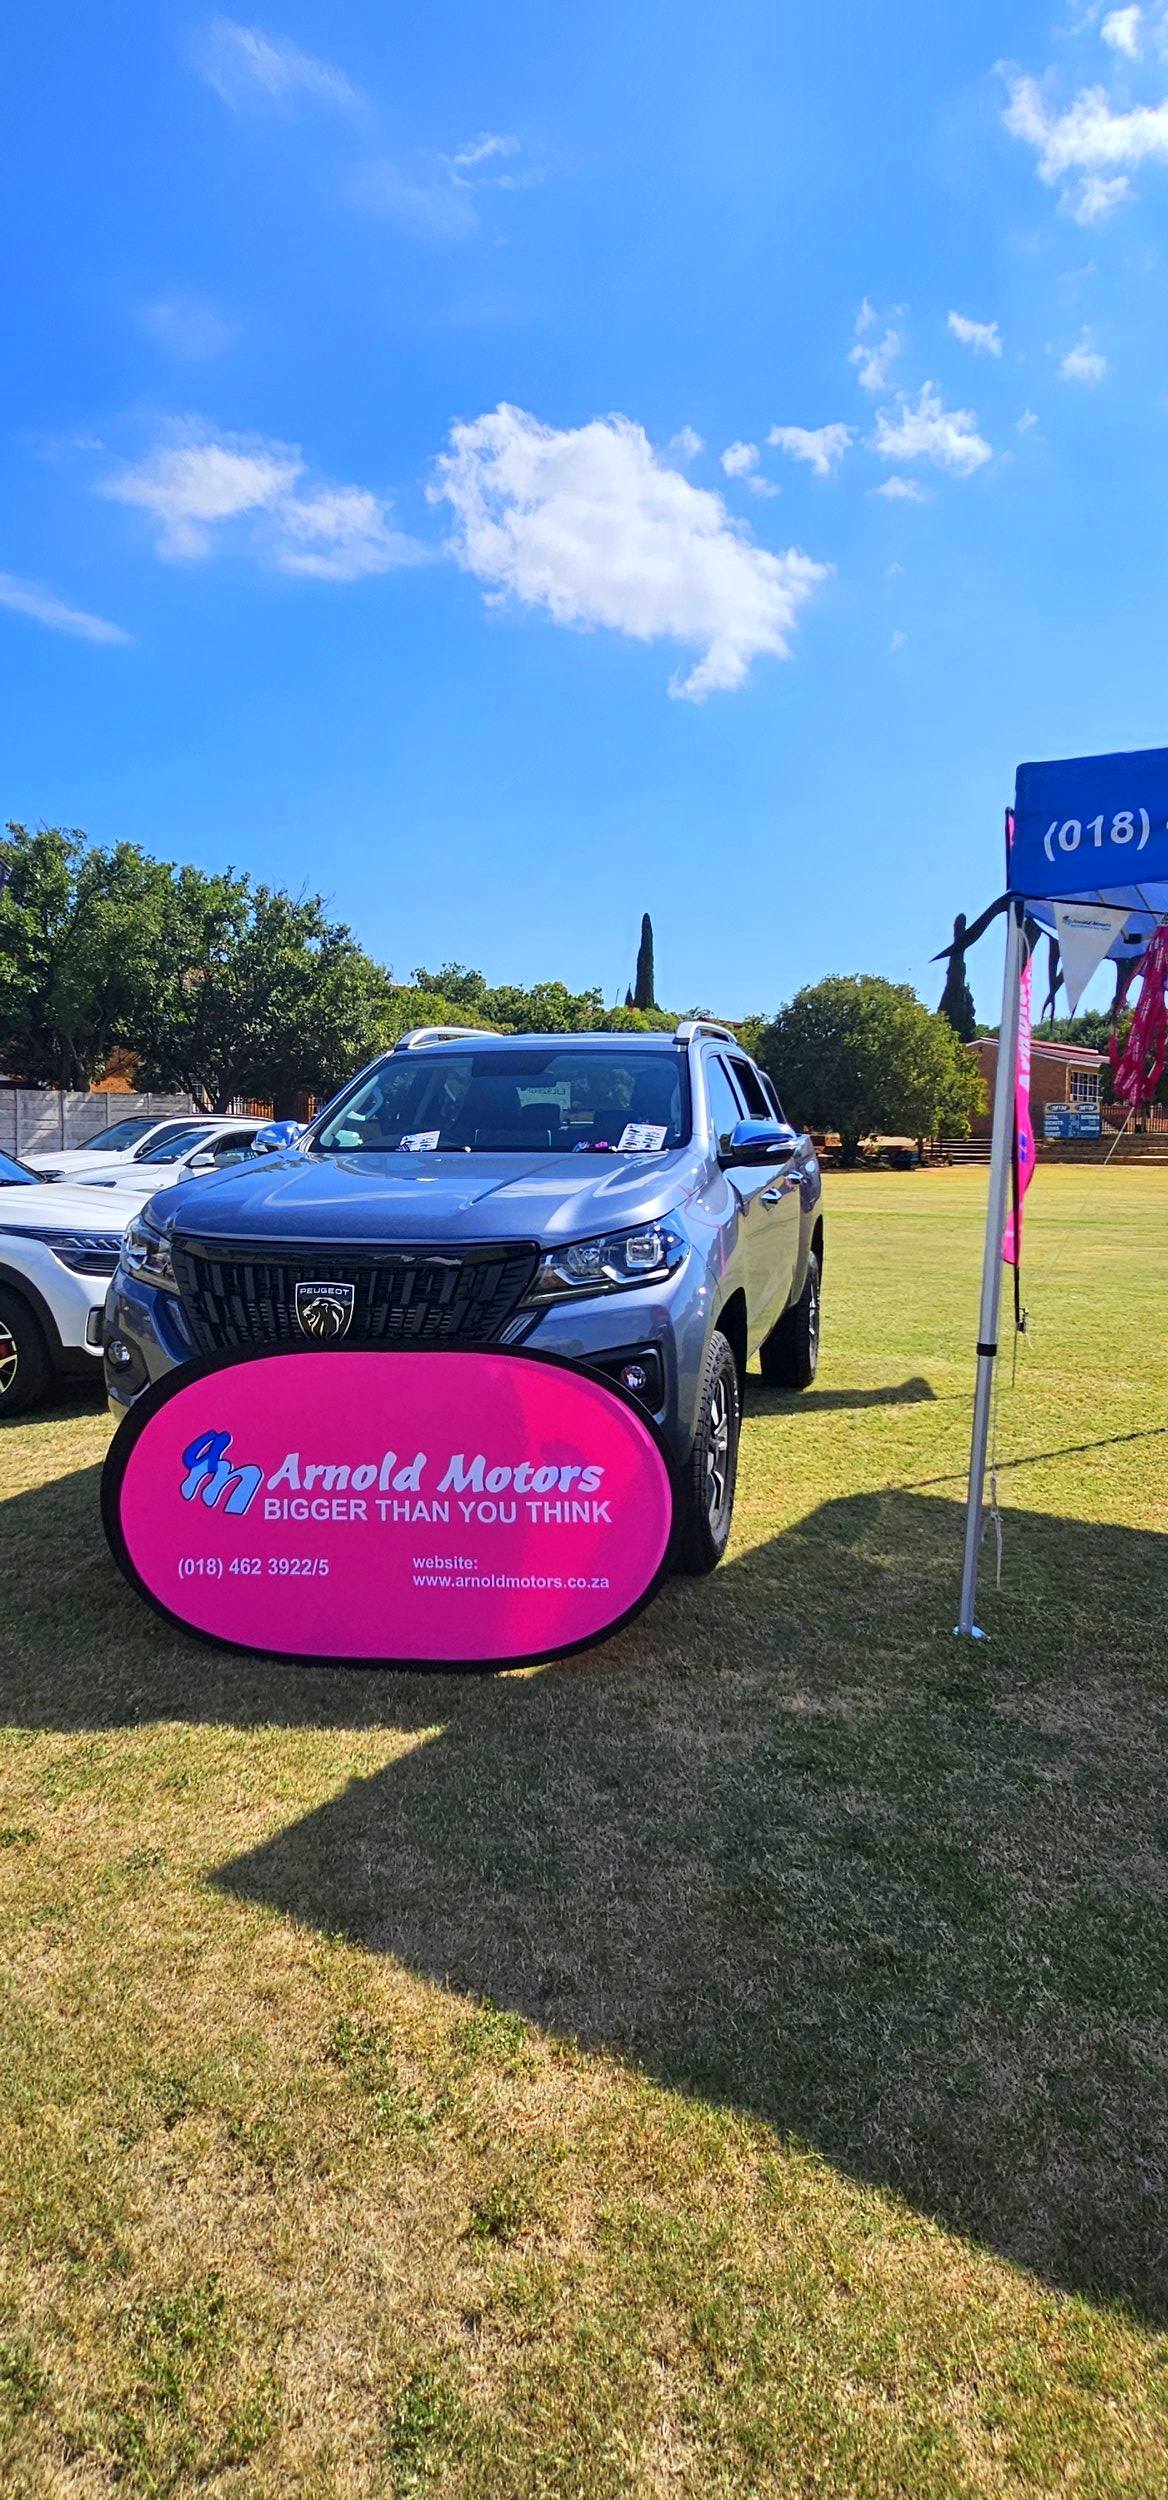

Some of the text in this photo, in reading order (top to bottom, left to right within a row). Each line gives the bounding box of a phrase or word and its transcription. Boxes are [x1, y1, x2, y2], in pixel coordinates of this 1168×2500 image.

[1043, 808, 1150, 862] (018)
[299, 1287, 350, 1296] PEUGEOT
[266, 1450, 605, 1494] Arnold Motors
[264, 1498, 612, 1524] BIGGER THAN YOU THINK
[178, 1558, 329, 1579] (018) 462 3922/5
[412, 1555, 477, 1570] website:
[412, 1573, 610, 1589] www.arnoldmotors.co.za
